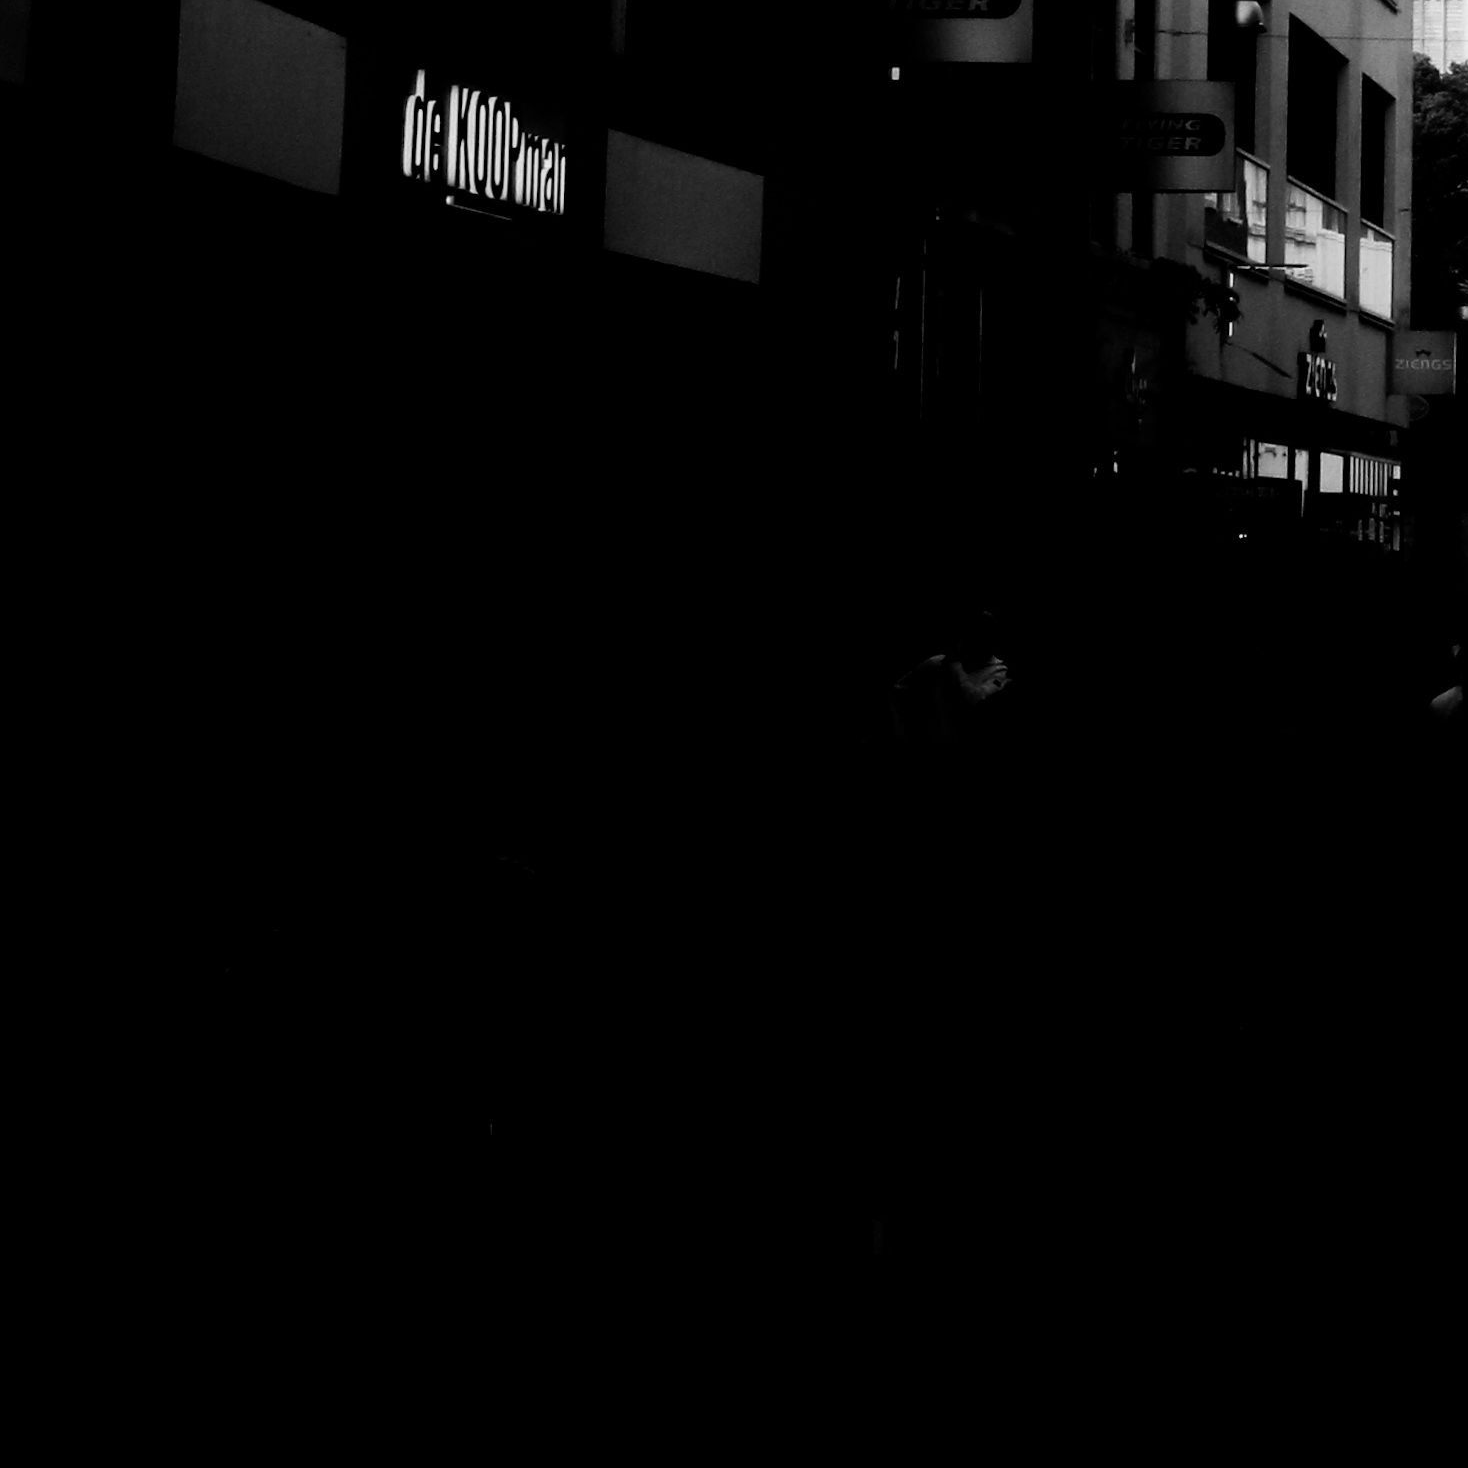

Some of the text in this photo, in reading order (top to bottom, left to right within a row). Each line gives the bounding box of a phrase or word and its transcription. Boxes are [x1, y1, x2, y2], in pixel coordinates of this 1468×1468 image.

[402, 68, 567, 215] de KOOPman
[1120, 136, 1202, 151] TIGER
